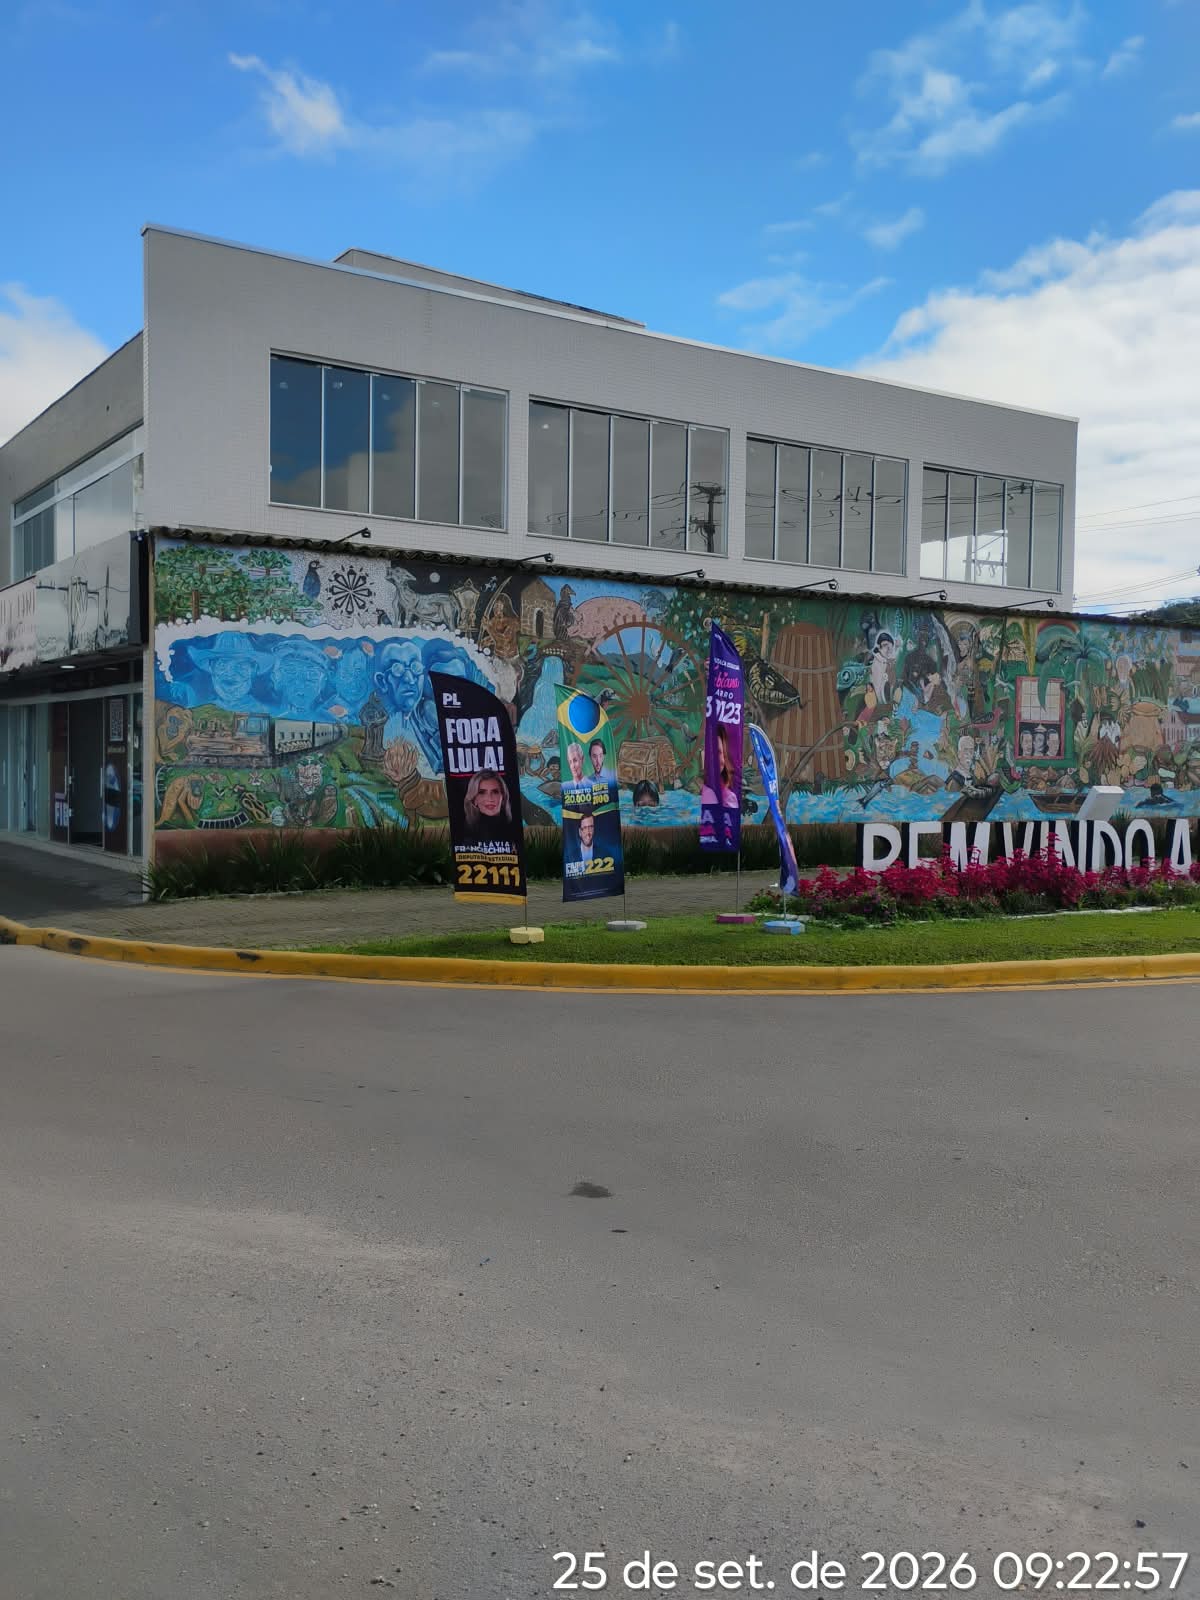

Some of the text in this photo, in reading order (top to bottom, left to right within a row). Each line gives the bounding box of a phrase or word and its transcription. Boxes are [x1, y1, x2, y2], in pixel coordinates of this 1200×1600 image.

[442, 692, 461, 706] PL
[445, 716, 501, 744] FORA
[447, 746, 505, 773] LULA!
[457, 864, 520, 887] 22111
[585, 856, 615, 875] 222
